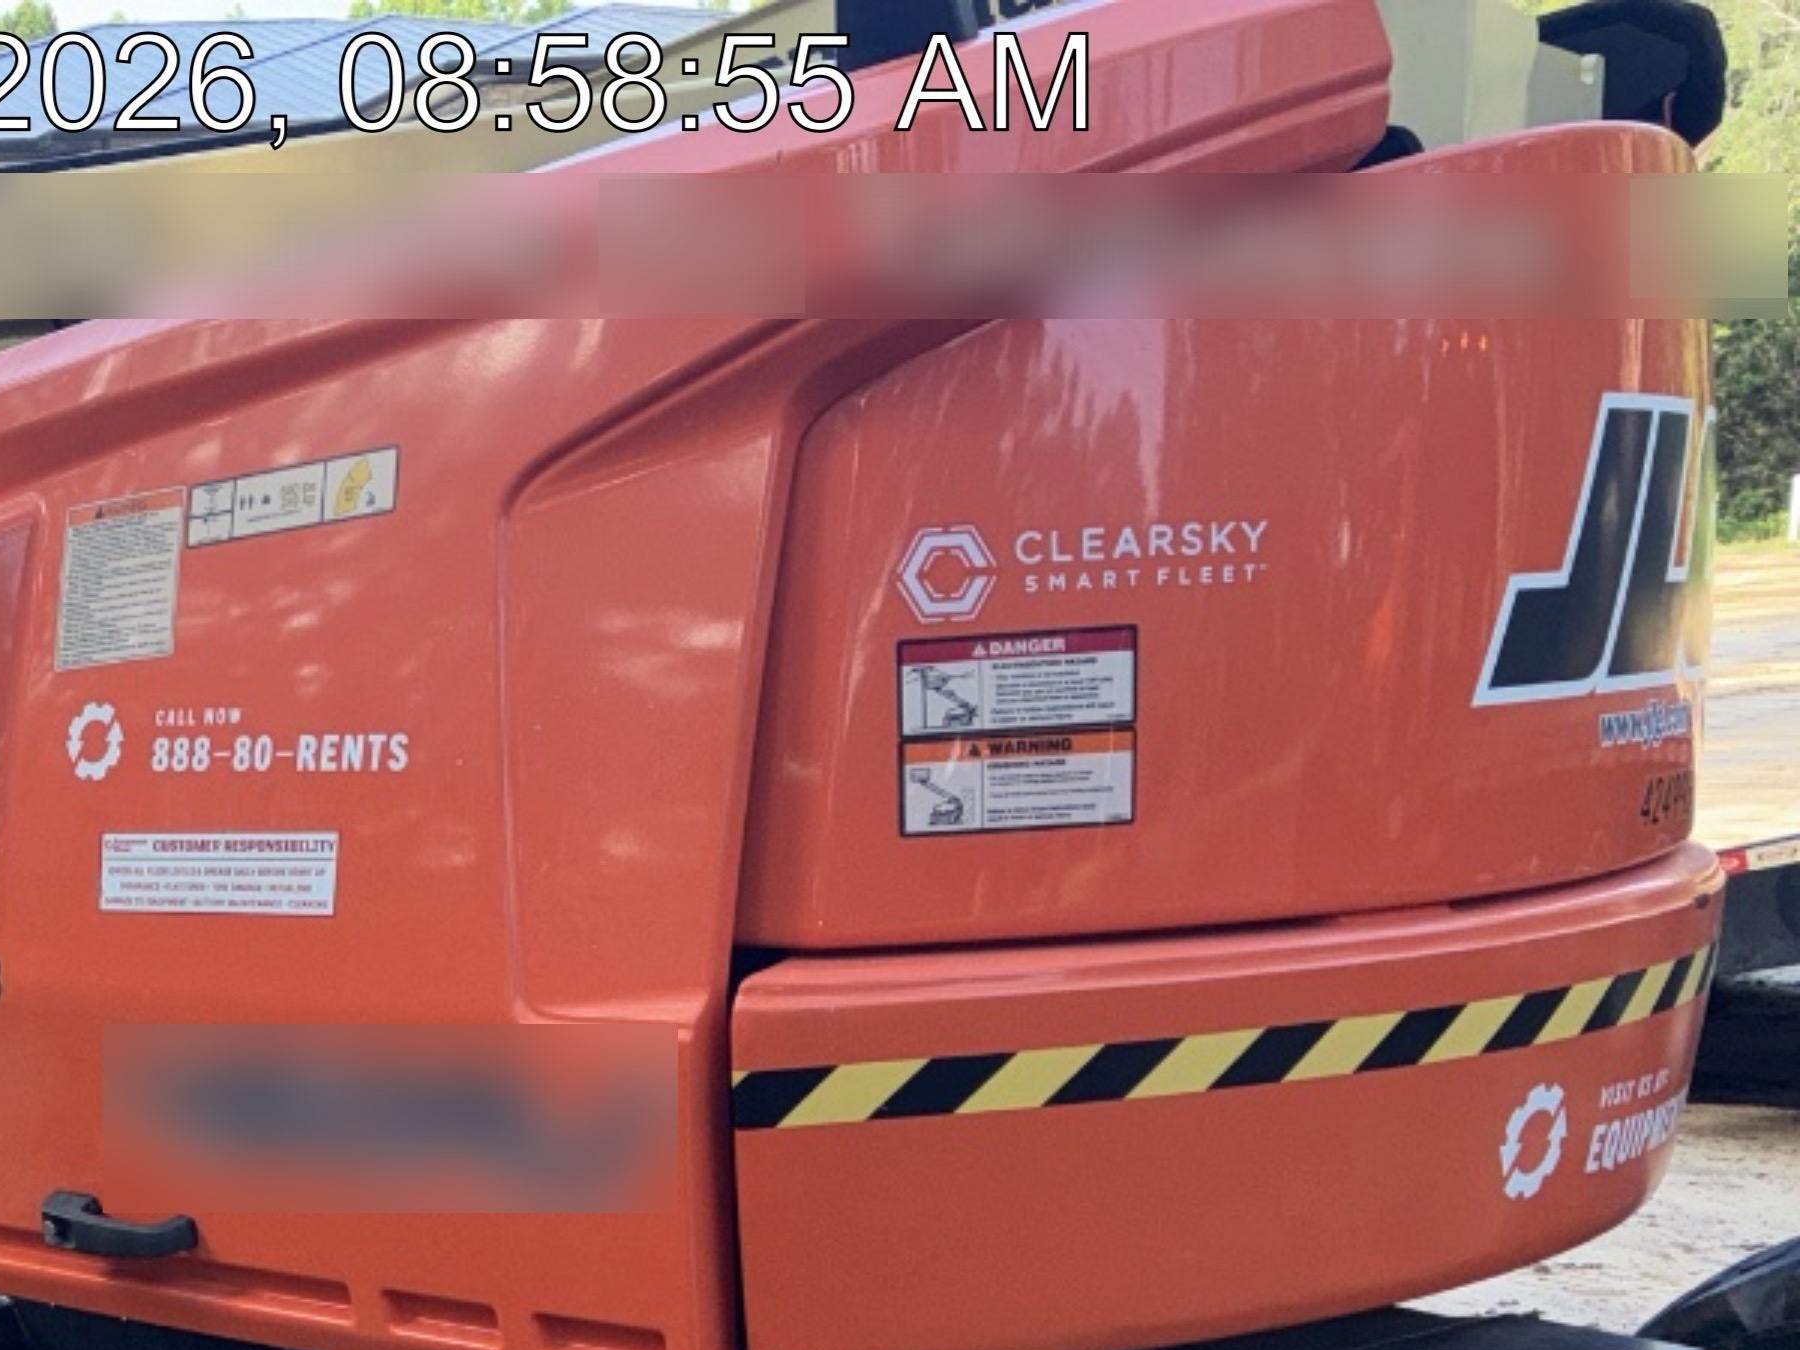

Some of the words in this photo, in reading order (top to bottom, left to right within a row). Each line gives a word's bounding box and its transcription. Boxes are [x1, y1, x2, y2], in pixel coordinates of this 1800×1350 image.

[1013, 520, 1270, 565] CLEARSKY
[1024, 569, 1143, 593] SMART
[1156, 563, 1260, 587] FLEET
[988, 637, 1067, 656] DANGER
[154, 708, 196, 727] CALL
[202, 707, 242, 726] NOW
[151, 732, 410, 773] 888-80-RENTS
[986, 737, 1073, 756] WARNING
[151, 838, 221, 853] CUSTOMER
[224, 838, 335, 854] RESPONSIBILITY
